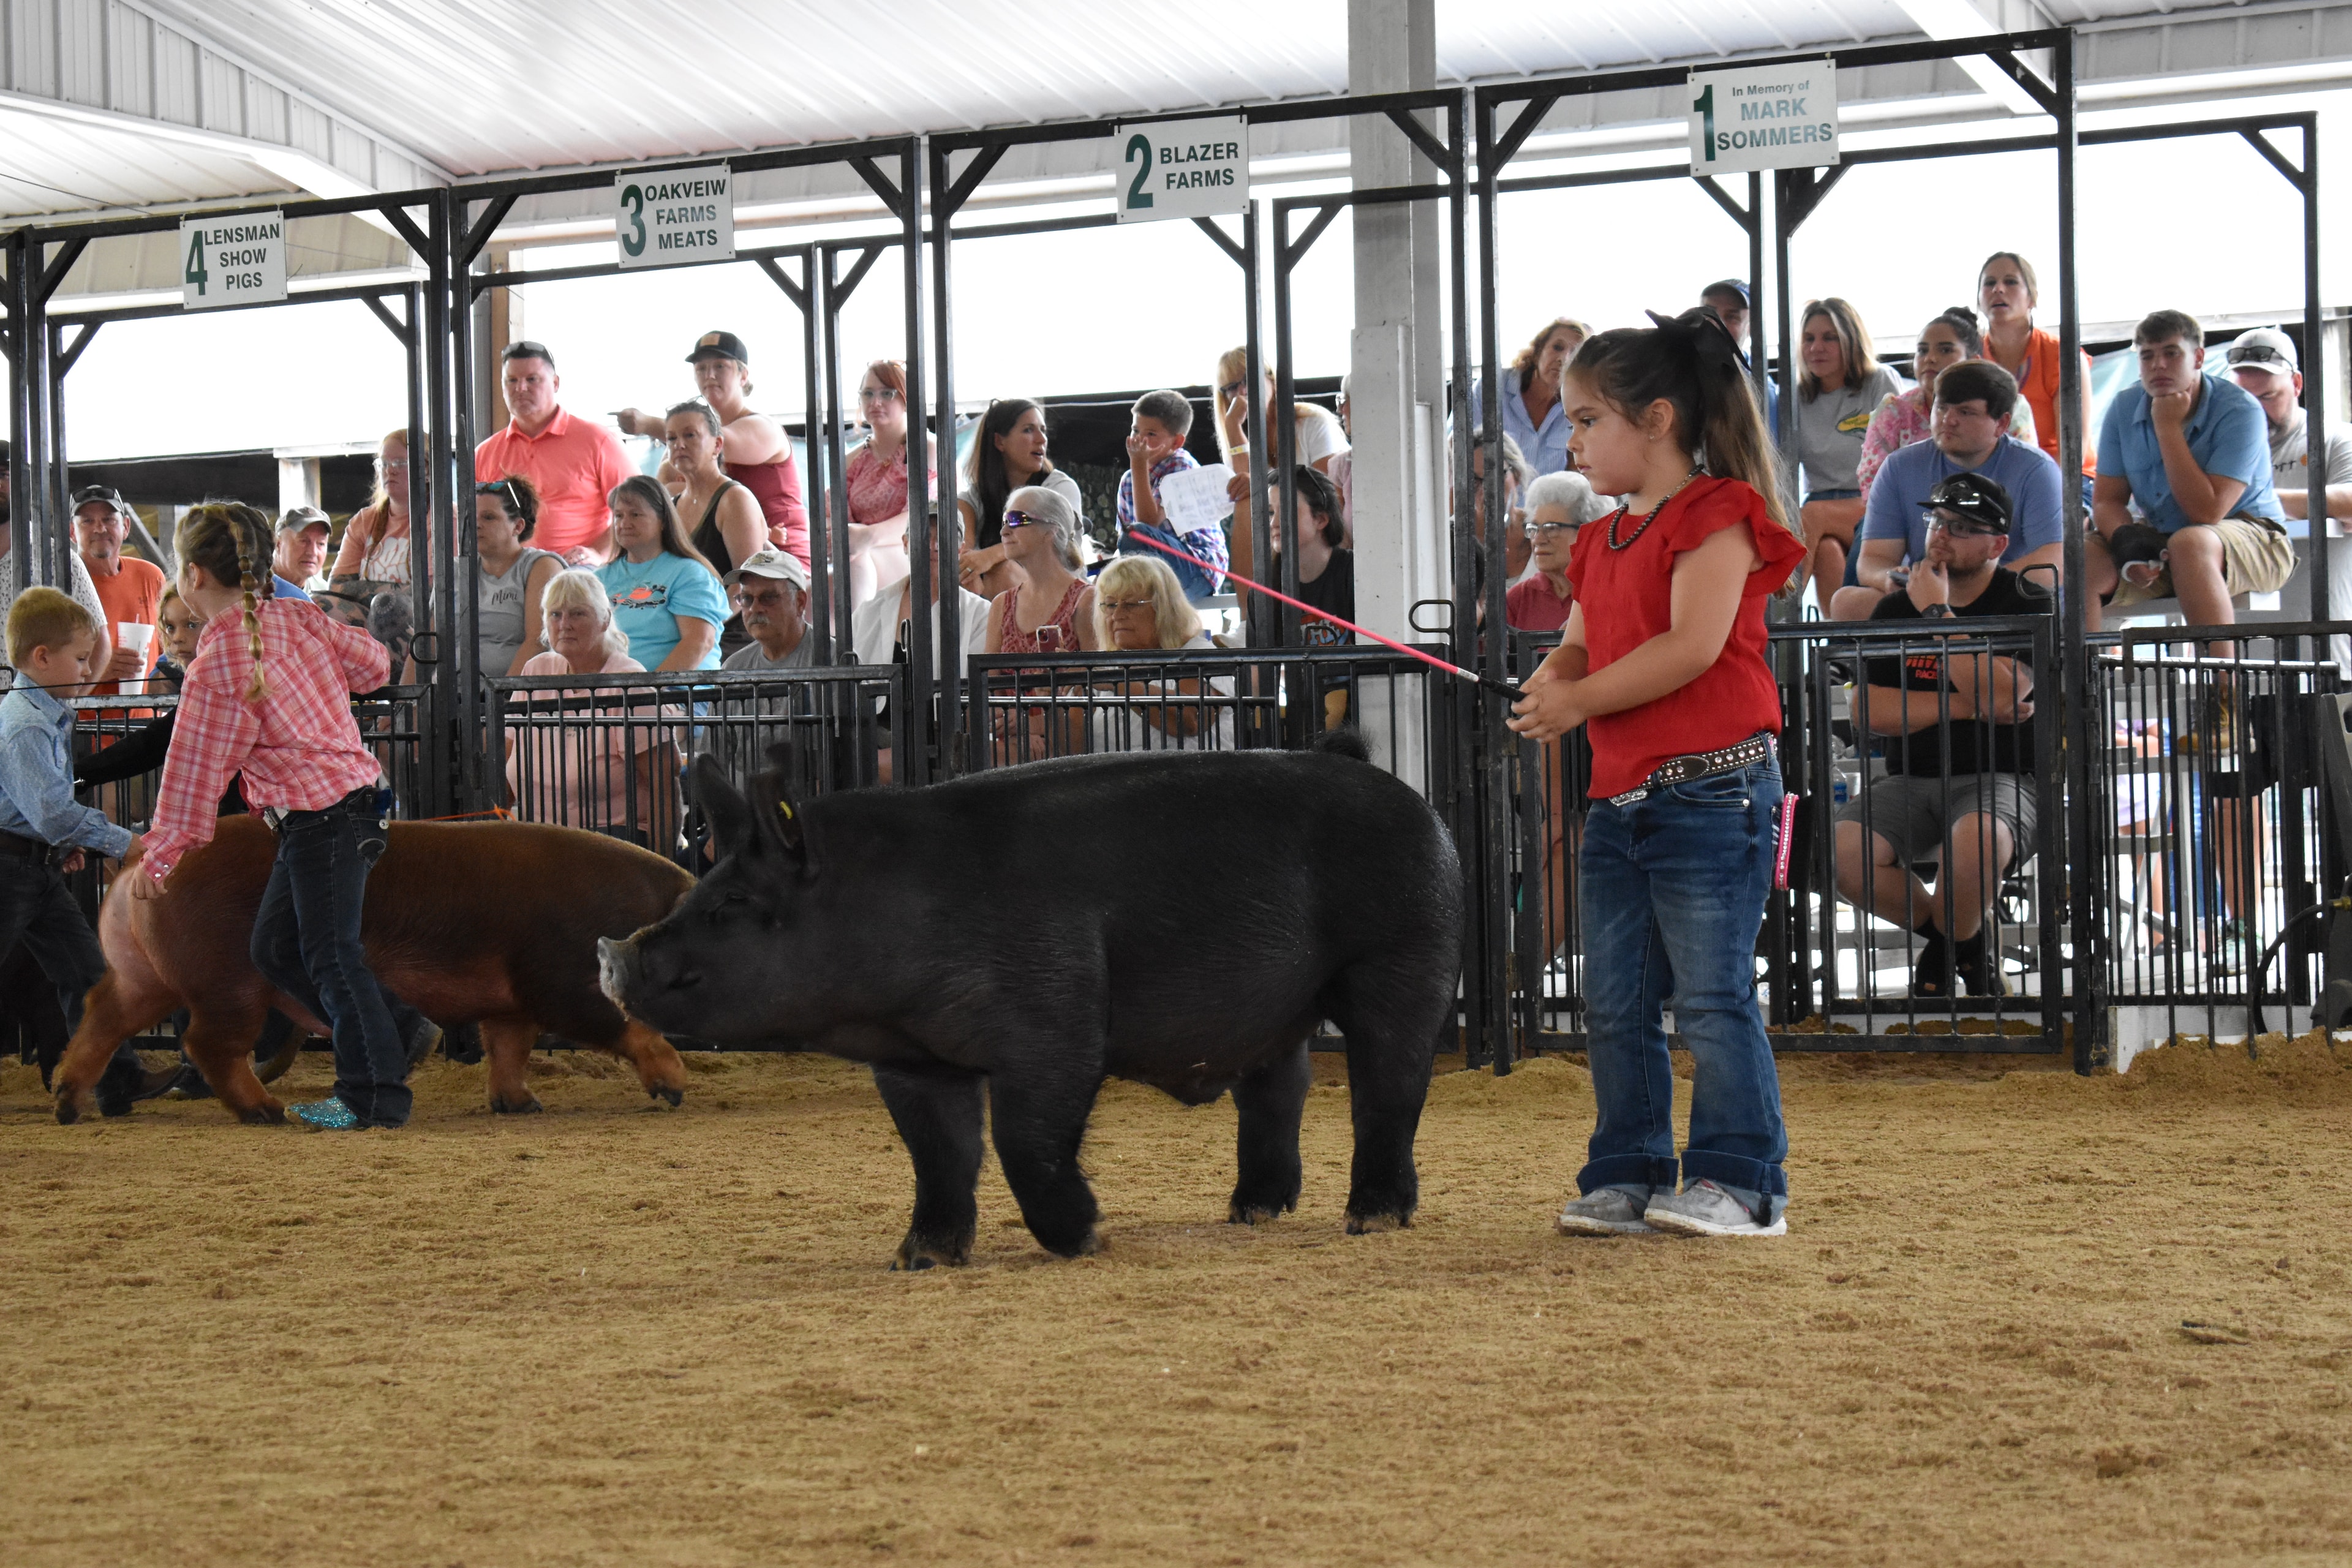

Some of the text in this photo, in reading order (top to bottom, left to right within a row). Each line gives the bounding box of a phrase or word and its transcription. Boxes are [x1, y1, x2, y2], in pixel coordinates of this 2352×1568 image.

[1732, 80, 1809, 97] In Memory of
[1741, 97, 1807, 121] MARK
[1693, 84, 1716, 162] 1
[1717, 123, 1833, 151] SOMMERS
[1160, 142, 1239, 164] BLAZER
[1125, 134, 1154, 209] 2
[1166, 168, 1235, 190] FARMS
[645, 179, 726, 202] OAKVEIW
[620, 184, 647, 257] 3
[656, 204, 717, 225] FARMS
[205, 223, 280, 246] LENSMAN
[658, 229, 718, 250] MEATS
[186, 230, 208, 296] 4
[219, 248, 267, 268] SHOW
[226, 272, 263, 290] PIGS
[491, 589, 518, 605] Mimi
